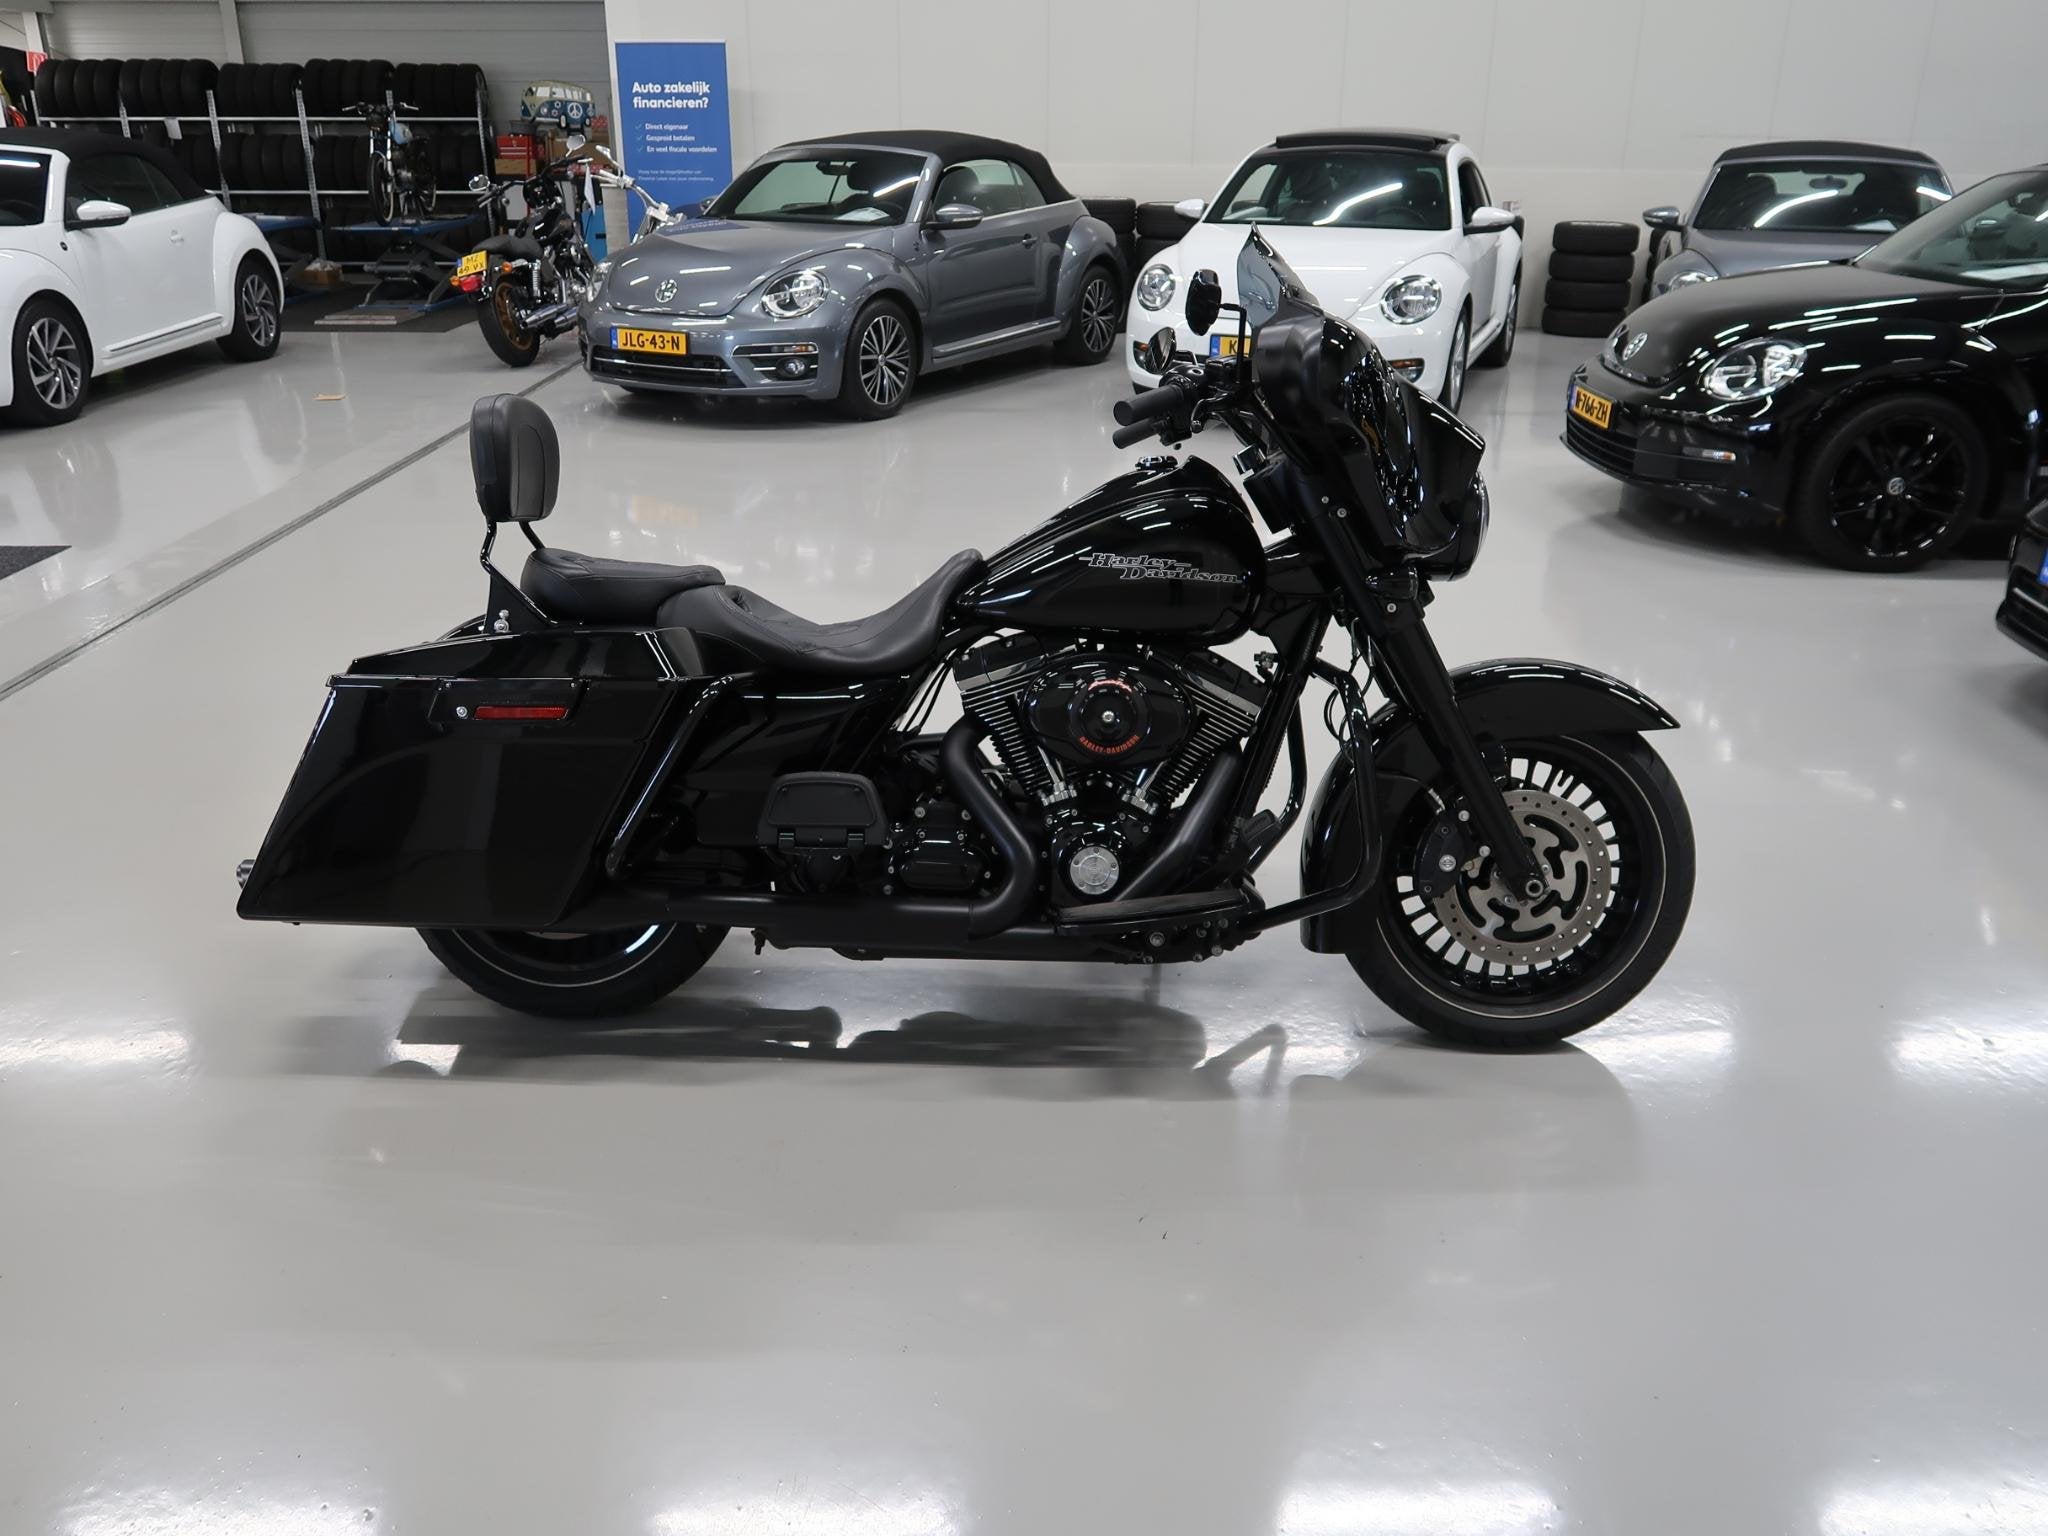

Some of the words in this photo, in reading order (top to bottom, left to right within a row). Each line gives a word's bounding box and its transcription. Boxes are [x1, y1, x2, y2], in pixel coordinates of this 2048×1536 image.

[632, 82, 661, 93] Auto
[664, 81, 710, 96] zakelijk
[633, 96, 709, 108] financieren?
[664, 123, 688, 131] eigenaar
[622, 332, 680, 351] JLG-43-N
[1087, 553, 1177, 569] Harley
[1120, 566, 1242, 583] Davidson
